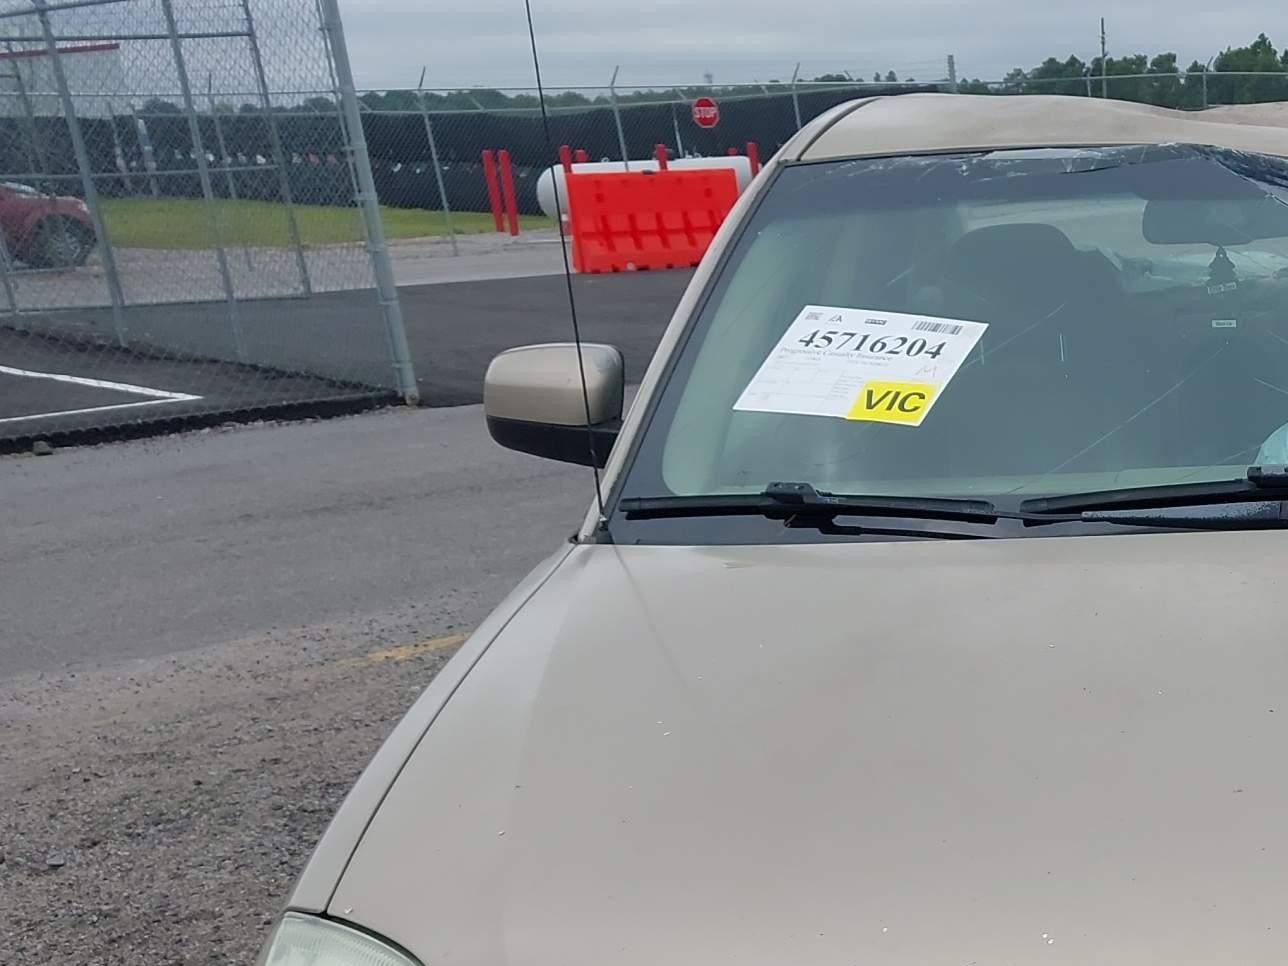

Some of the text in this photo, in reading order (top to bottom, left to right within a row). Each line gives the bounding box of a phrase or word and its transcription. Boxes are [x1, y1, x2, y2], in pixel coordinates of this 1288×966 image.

[695, 106, 717, 118] STOP
[798, 329, 946, 360] 45716204
[864, 389, 926, 413] VIC
